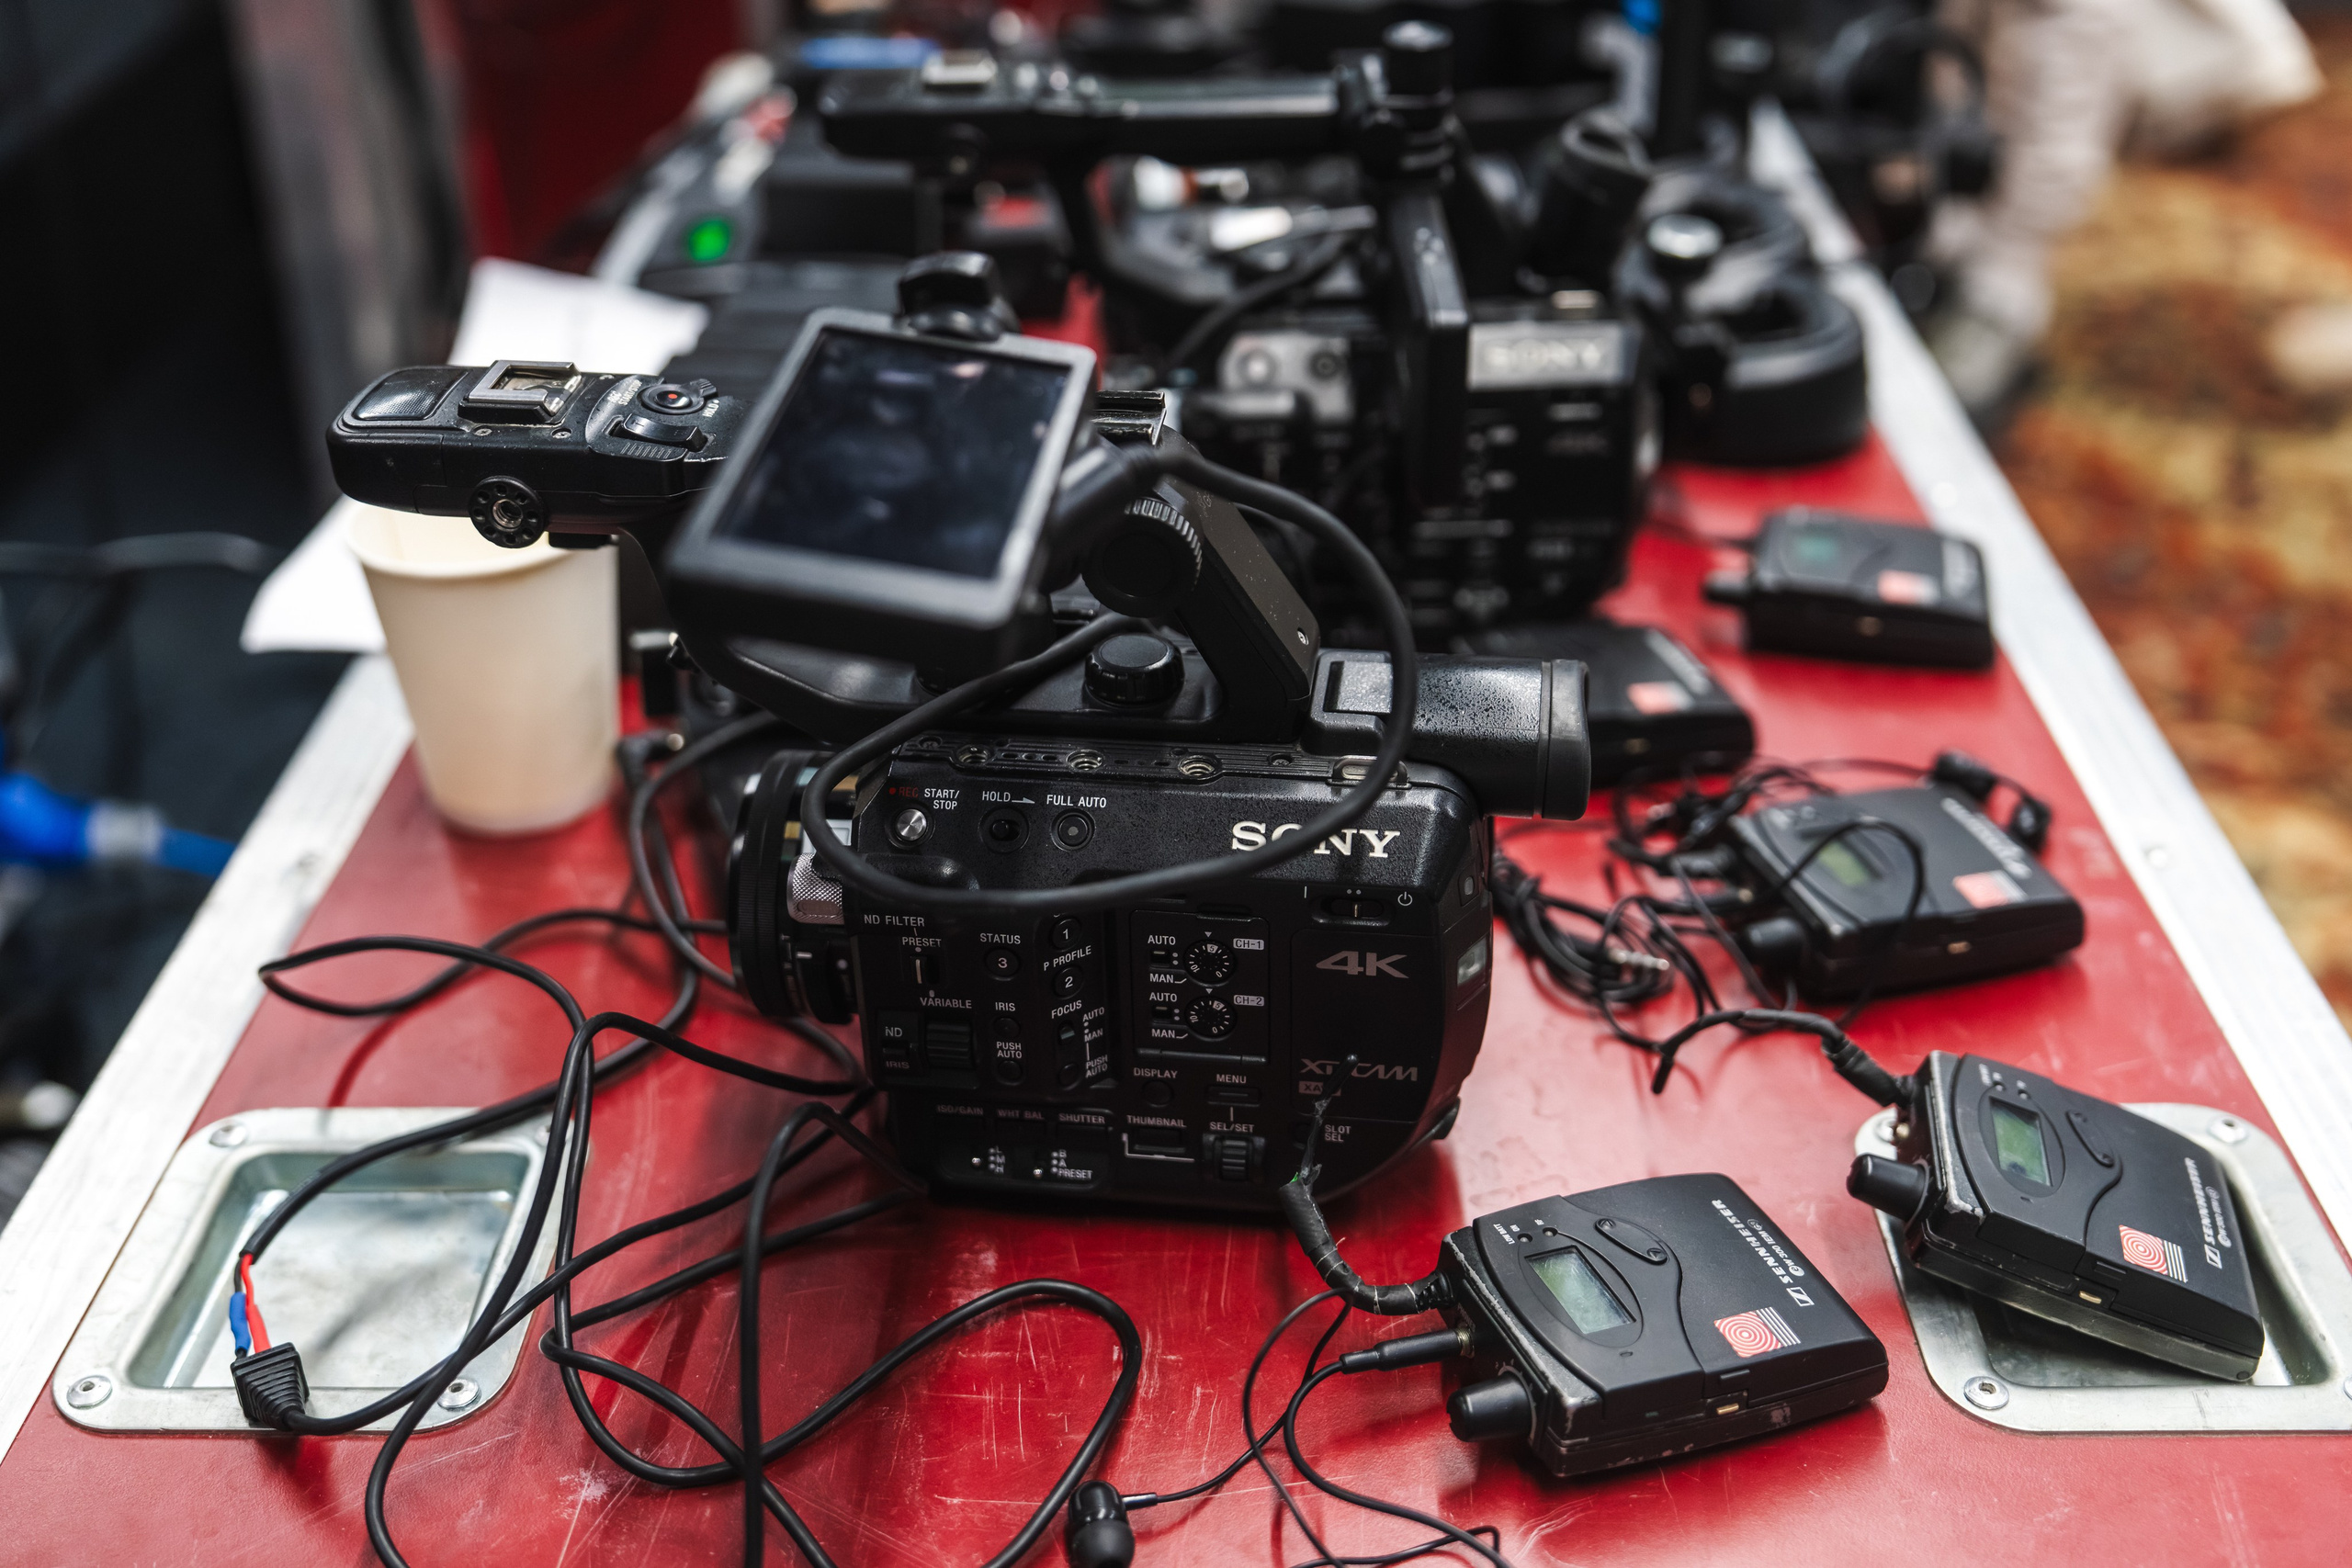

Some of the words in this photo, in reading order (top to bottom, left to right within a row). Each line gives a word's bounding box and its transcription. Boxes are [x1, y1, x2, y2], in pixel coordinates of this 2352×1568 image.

[899, 786, 919, 797] REC
[924, 788, 959, 798] START/
[982, 791, 1011, 802] HOLD
[933, 800, 958, 809] STOP
[1046, 795, 1074, 807] FULL
[1078, 796, 1107, 808] AUTO
[864, 915, 880, 925] ND
[885, 916, 924, 927] FILTER
[979, 933, 1021, 944] STATUS
[1062, 929, 1069, 940] 1
[1148, 935, 1176, 945] AUTO
[902, 936, 942, 947] PRESET
[1235, 939, 1262, 949] CH-1
[998, 957, 1008, 968] 3
[1043, 961, 1050, 971] P
[1053, 945, 1091, 967] PROFILE
[1316, 950, 1409, 979] 4K
[1065, 976, 1073, 988] 2
[1149, 974, 1174, 983] MAN
[1148, 992, 1178, 1002] AUTO
[1235, 995, 1262, 1006] CH-2
[920, 997, 972, 1009] VARIABLE
[995, 1002, 1016, 1011] IRIS
[1051, 1000, 1082, 1019] FOCUS
[1082, 1007, 1105, 1021] AUTO
[885, 1026, 903, 1037] ND
[1084, 1028, 1103, 1043] MAN
[1151, 1029, 1176, 1039] MAN
[996, 1042, 1022, 1051] PUSH
[997, 1050, 1023, 1059] AUTO
[886, 1061, 910, 1069] IRIS
[1085, 1055, 1108, 1069] PUSH
[1085, 1063, 1108, 1078] AUTO
[1133, 1067, 1178, 1078] DISPLAY
[1216, 1074, 1247, 1084] MENU
[997, 1109, 1020, 1118] WHT
[1023, 1111, 1045, 1120] BAL
[1058, 1112, 1105, 1124] SHUTTER
[1126, 1114, 1187, 1128] THUMBNAIL
[1210, 1122, 1255, 1133] SEL/SET
[1325, 1124, 1351, 1134] SLOT
[1325, 1133, 1344, 1142] SEL
[996, 1156, 1006, 1164] M
[1058, 1159, 1067, 1168] A
[1058, 1168, 1093, 1180] PRESET
[1493, 1224, 1507, 1235] BATT
[1502, 1234, 1515, 1245] LOW
[1712, 1200, 1794, 1284] SENNHEISER
[1758, 1231, 1776, 1245] IEM
[1771, 1245, 1789, 1258] 300
